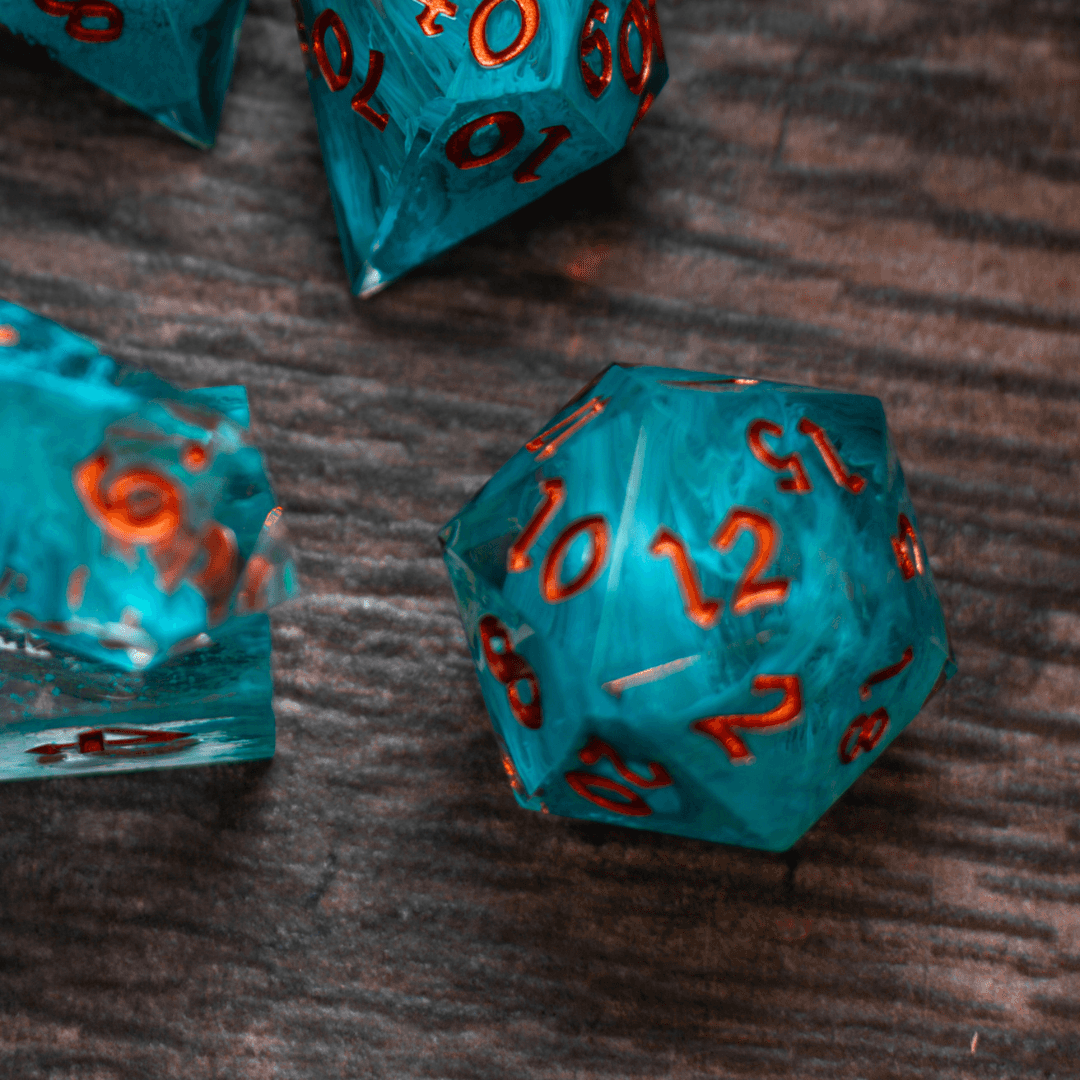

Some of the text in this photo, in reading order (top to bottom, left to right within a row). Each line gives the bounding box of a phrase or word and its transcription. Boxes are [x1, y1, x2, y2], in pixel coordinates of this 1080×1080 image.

[745, 415, 868, 496] 15
[506, 476, 608, 606] 10
[649, 503, 792, 630] 12
[478, 612, 545, 731] 8
[563, 735, 675, 818] 20
